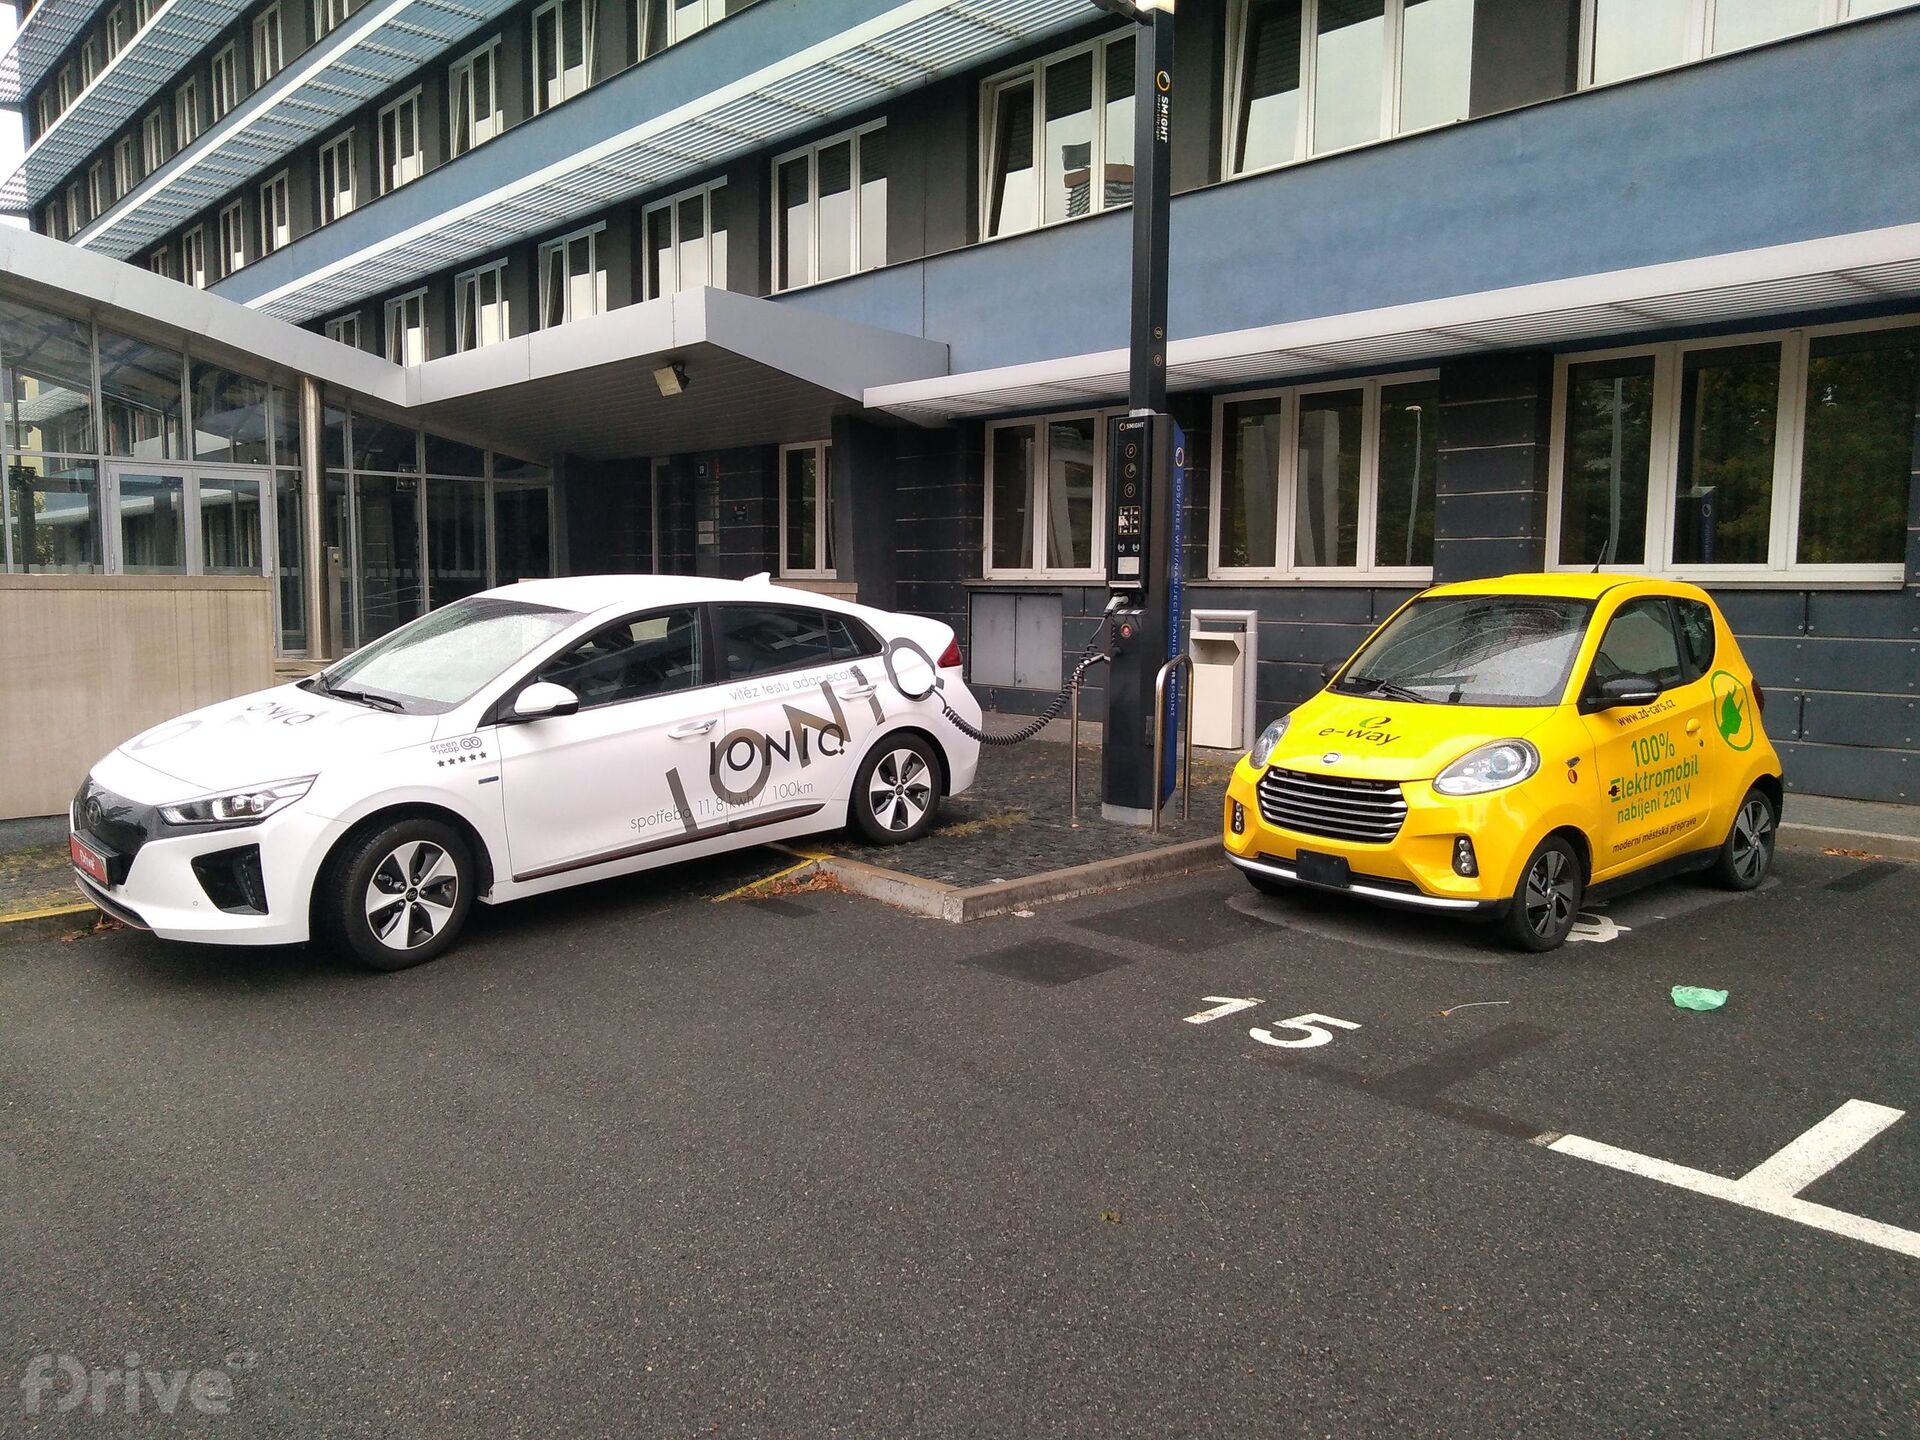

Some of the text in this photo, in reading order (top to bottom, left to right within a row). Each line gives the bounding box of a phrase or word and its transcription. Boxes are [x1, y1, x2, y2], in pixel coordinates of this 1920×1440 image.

[729, 685, 761, 701] vítěz
[761, 681, 790, 696] testu
[792, 673, 822, 690] adac
[1616, 699, 1677, 727] www.zd-cars.cz
[430, 741, 458, 753] green
[709, 723, 846, 776] IONIQ
[1318, 727, 1401, 746] e-way
[1631, 731, 1676, 767] 100%
[438, 746, 460, 755] ncap
[630, 803, 692, 833] spotřeba
[698, 795, 724, 817] 11,8
[773, 780, 814, 801] 100km
[1663, 786, 1681, 808] 220
[1684, 783, 1691, 800] V
[1612, 834, 1641, 854] moderní
